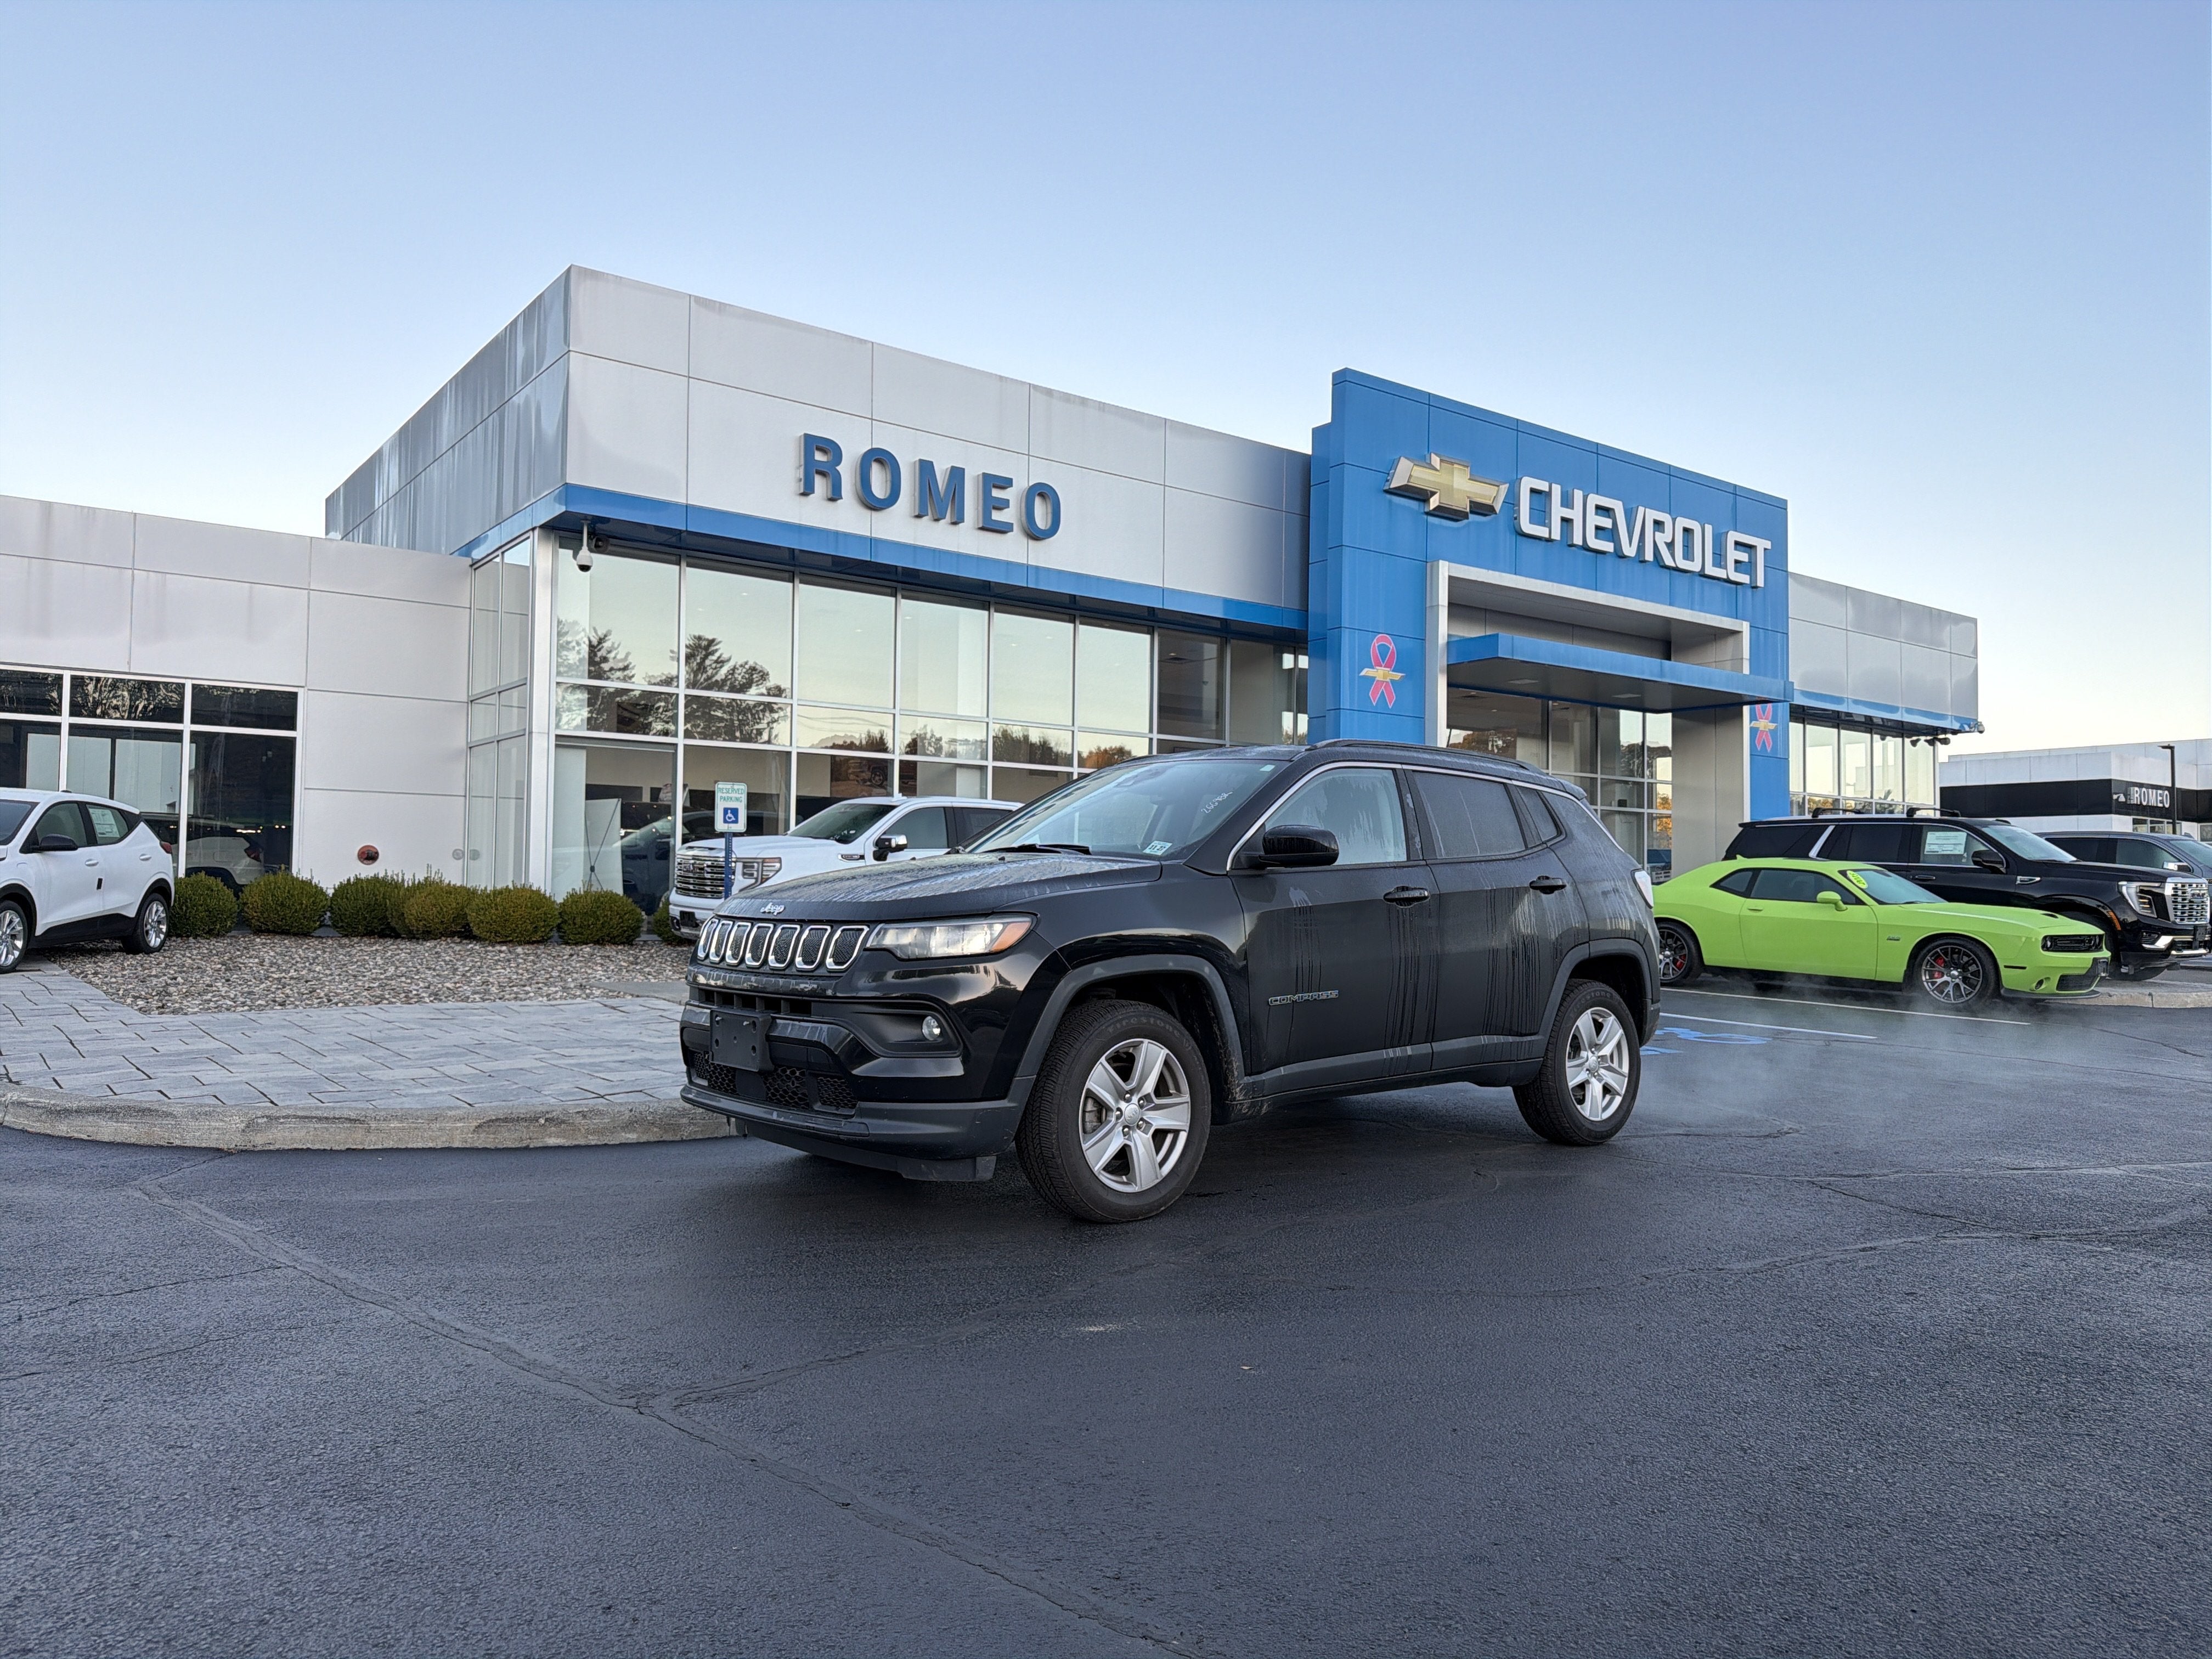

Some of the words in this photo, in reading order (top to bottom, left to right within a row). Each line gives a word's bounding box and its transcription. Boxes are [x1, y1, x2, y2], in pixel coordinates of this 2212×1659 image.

[800, 432, 1061, 540] ROMEO
[1515, 476, 1771, 588] CHEVROLET
[2131, 787, 2170, 808] ROMEO
[760, 902, 785, 916] Jeep
[1268, 990, 1339, 1006] COMPASS
[1107, 1017, 1181, 1037] Firestone
